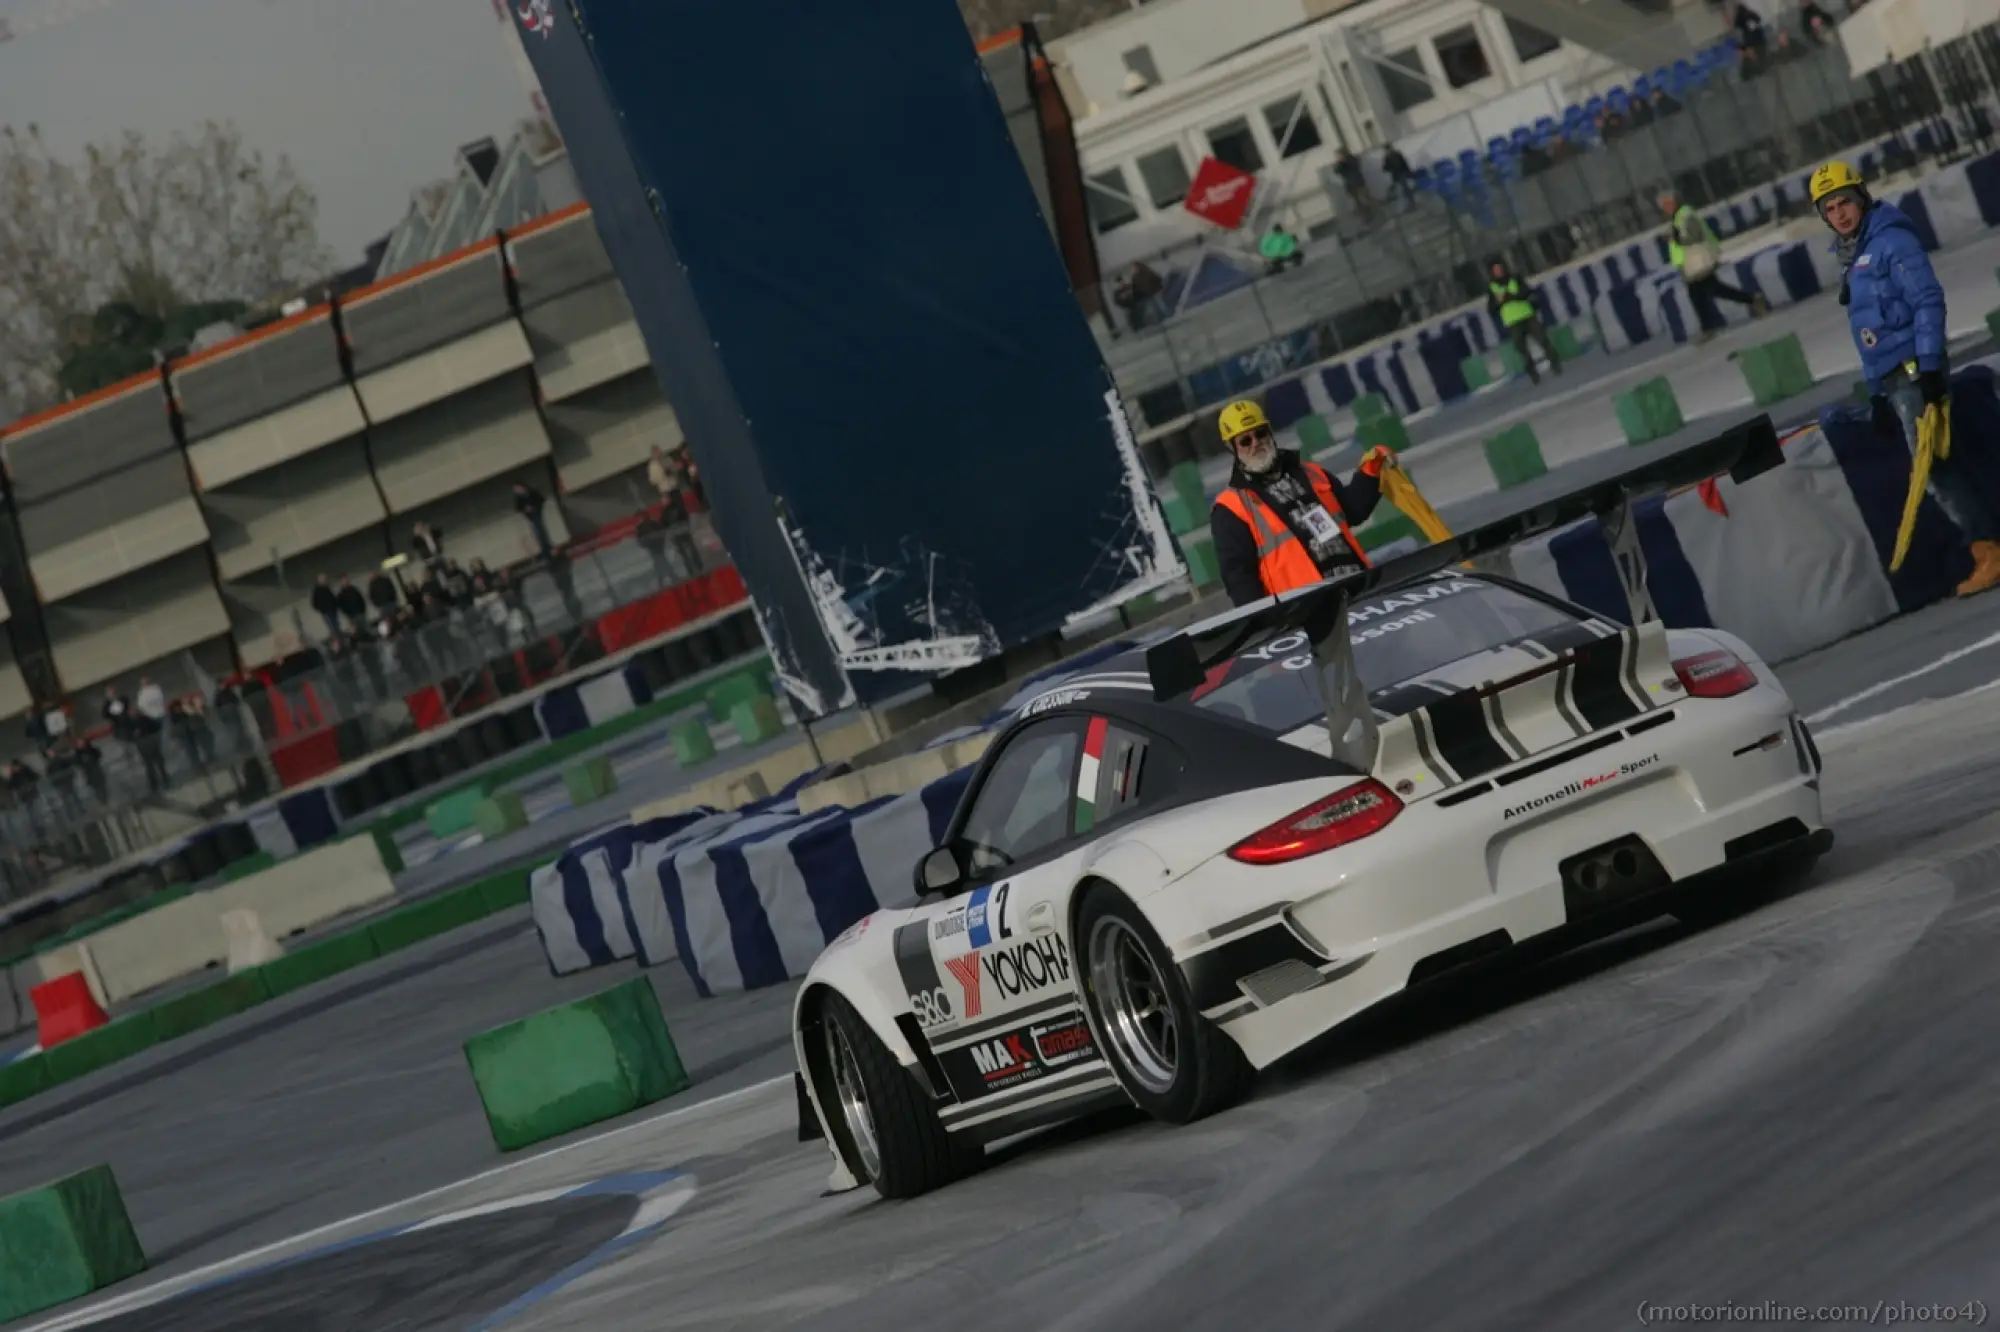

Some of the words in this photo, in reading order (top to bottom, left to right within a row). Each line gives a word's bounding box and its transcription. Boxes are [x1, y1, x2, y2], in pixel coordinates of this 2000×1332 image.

[1241, 581, 1484, 660] YOHAMA
[1281, 608, 1436, 671] Cssoni
[1504, 781, 1582, 820] Antonelli
[1620, 752, 1660, 774] Sport
[995, 883, 1012, 939] 2
[970, 1033, 1034, 1075] MAK
